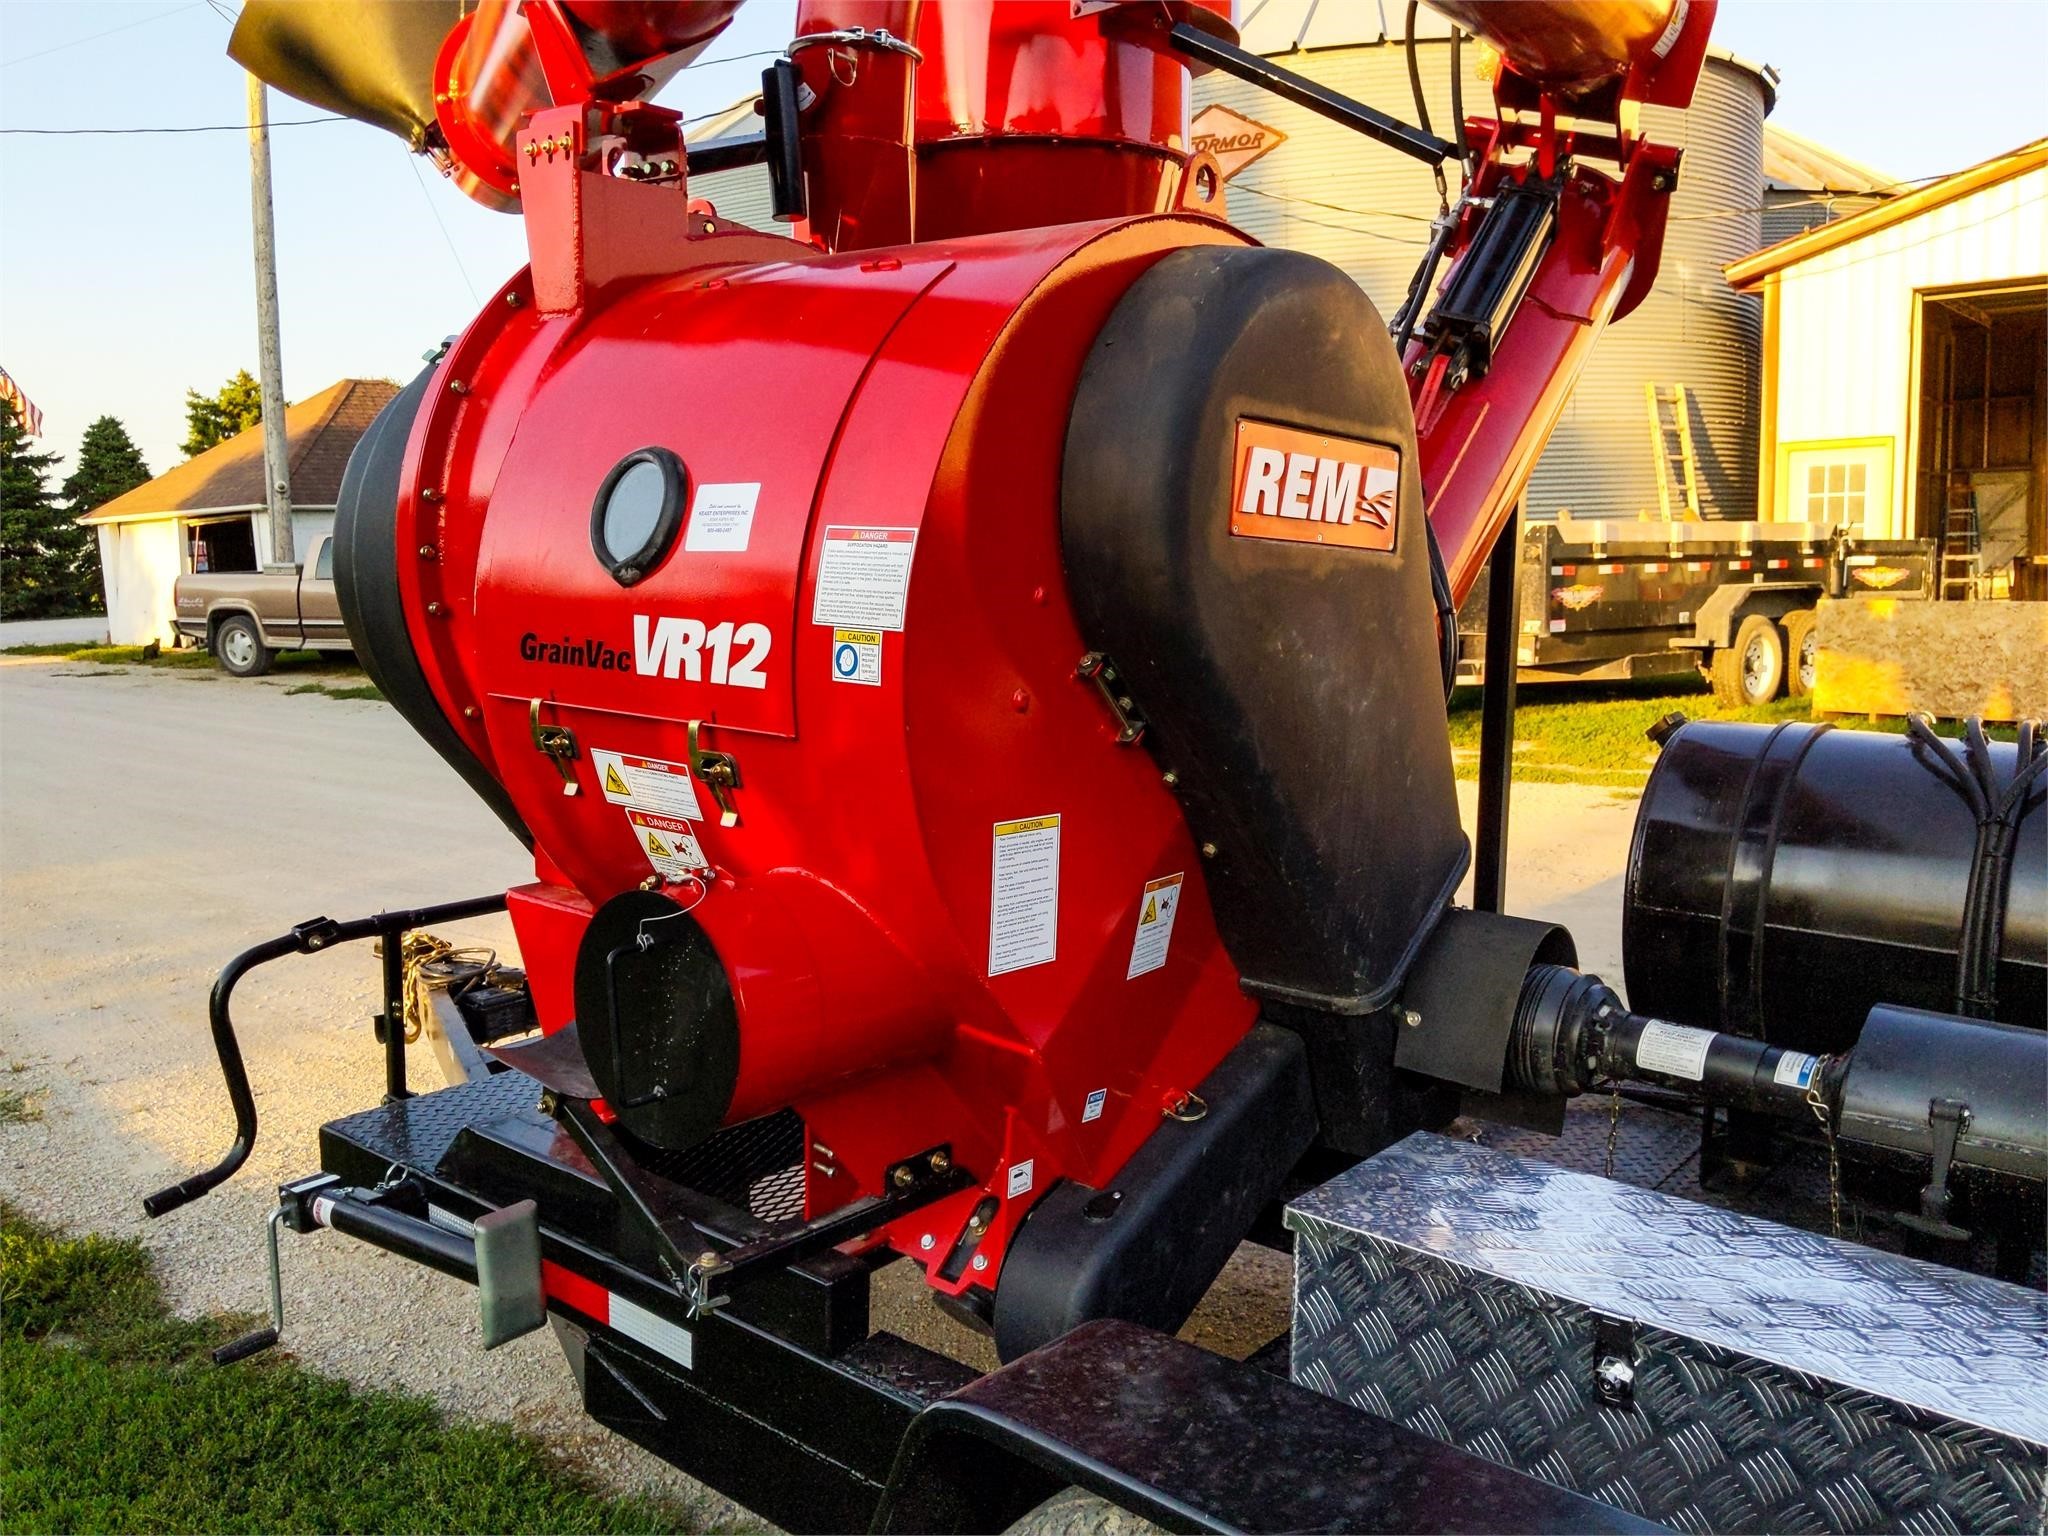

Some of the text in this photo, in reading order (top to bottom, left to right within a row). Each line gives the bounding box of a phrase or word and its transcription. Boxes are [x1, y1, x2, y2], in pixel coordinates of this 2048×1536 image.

[1240, 446, 1362, 525] REM
[860, 531, 889, 540] DANGER
[847, 633, 876, 642] CAUTION
[520, 614, 772, 690] GrainVac VR12
[646, 761, 669, 772] DANGER
[646, 816, 685, 832] DANGER
[1019, 821, 1043, 831] CAUTION
